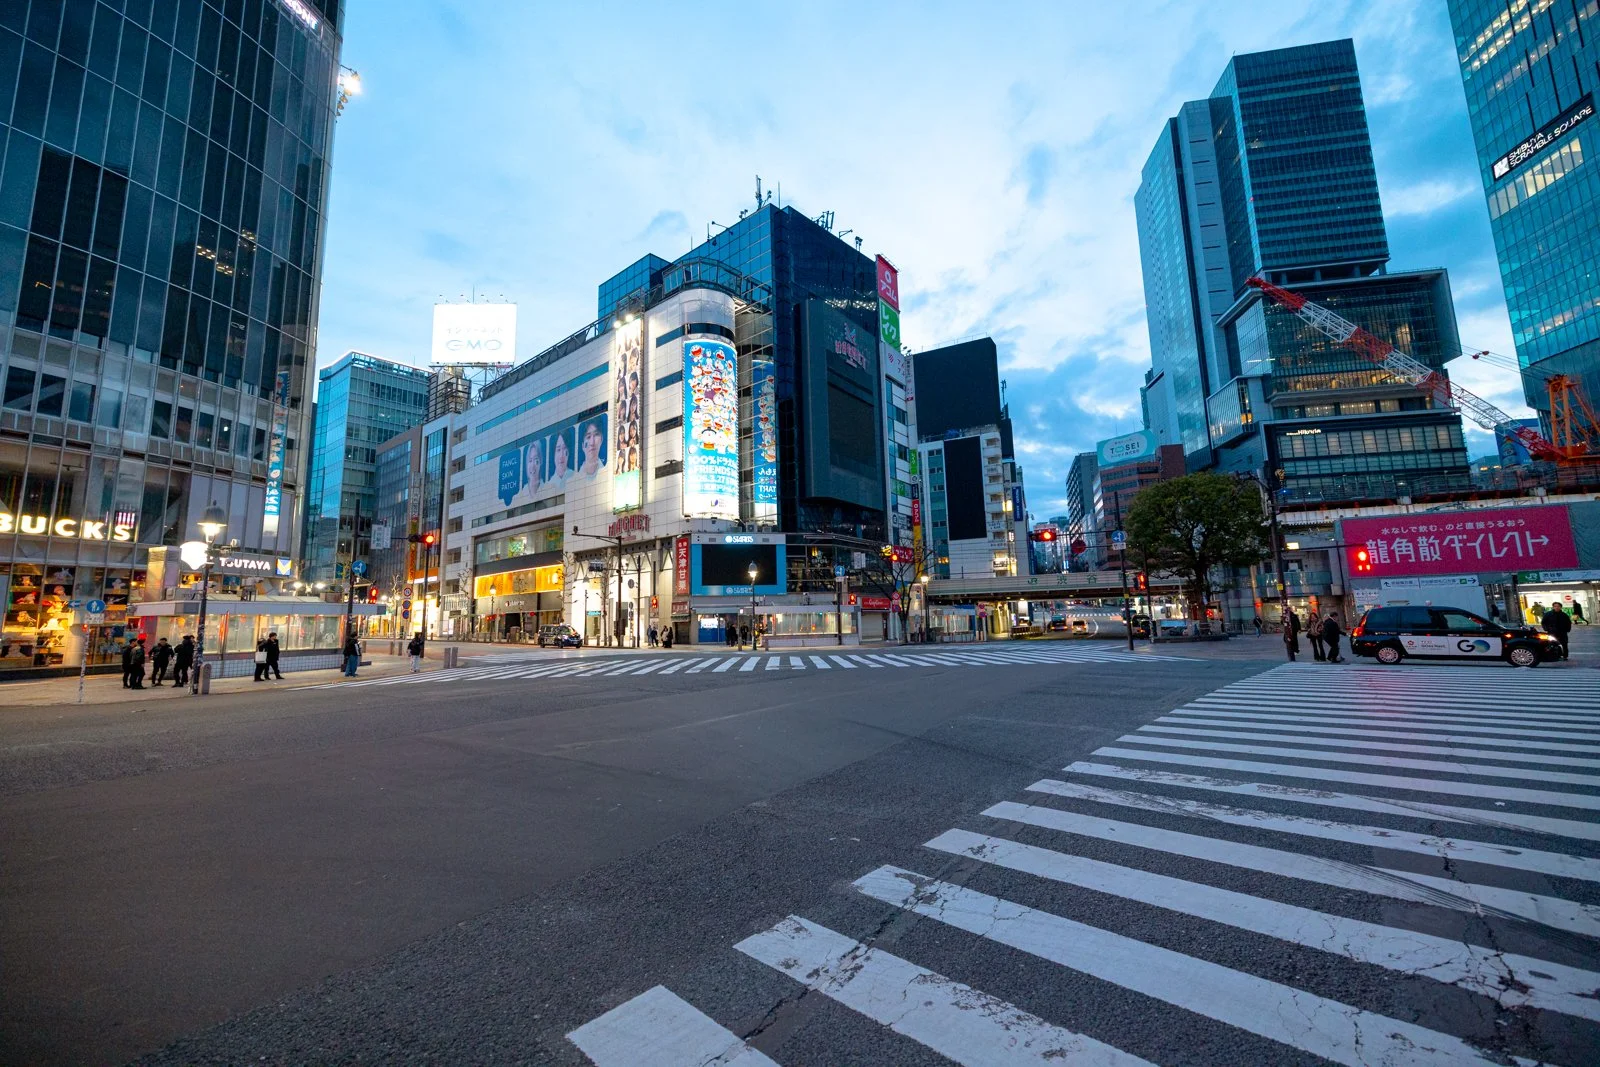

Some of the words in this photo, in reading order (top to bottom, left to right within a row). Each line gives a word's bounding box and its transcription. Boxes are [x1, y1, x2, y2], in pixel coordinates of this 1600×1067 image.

[1509, 133, 1554, 168] SCRAMBLE
[1554, 105, 1593, 137] SQUARE
[1508, 132, 1544, 161] SHIBUYA
[882, 304, 897, 340] レイク
[445, 339, 503, 351] GMO
[502, 457, 518, 468] FANCL
[501, 470, 514, 480] SKIN
[501, 481, 517, 491] PATCH
[608, 514, 649, 537] MAGNET
[1381, 518, 1526, 536] 水なしで飲む、のど直接うるおう
[1366, 530, 1549, 564] 龍角散ダイレクト
[678, 548, 687, 591] 天津甘栗
[1525, 572, 1538, 580] JR
[1027, 577, 1038, 585] JR
[1457, 639, 1491, 653] GO
